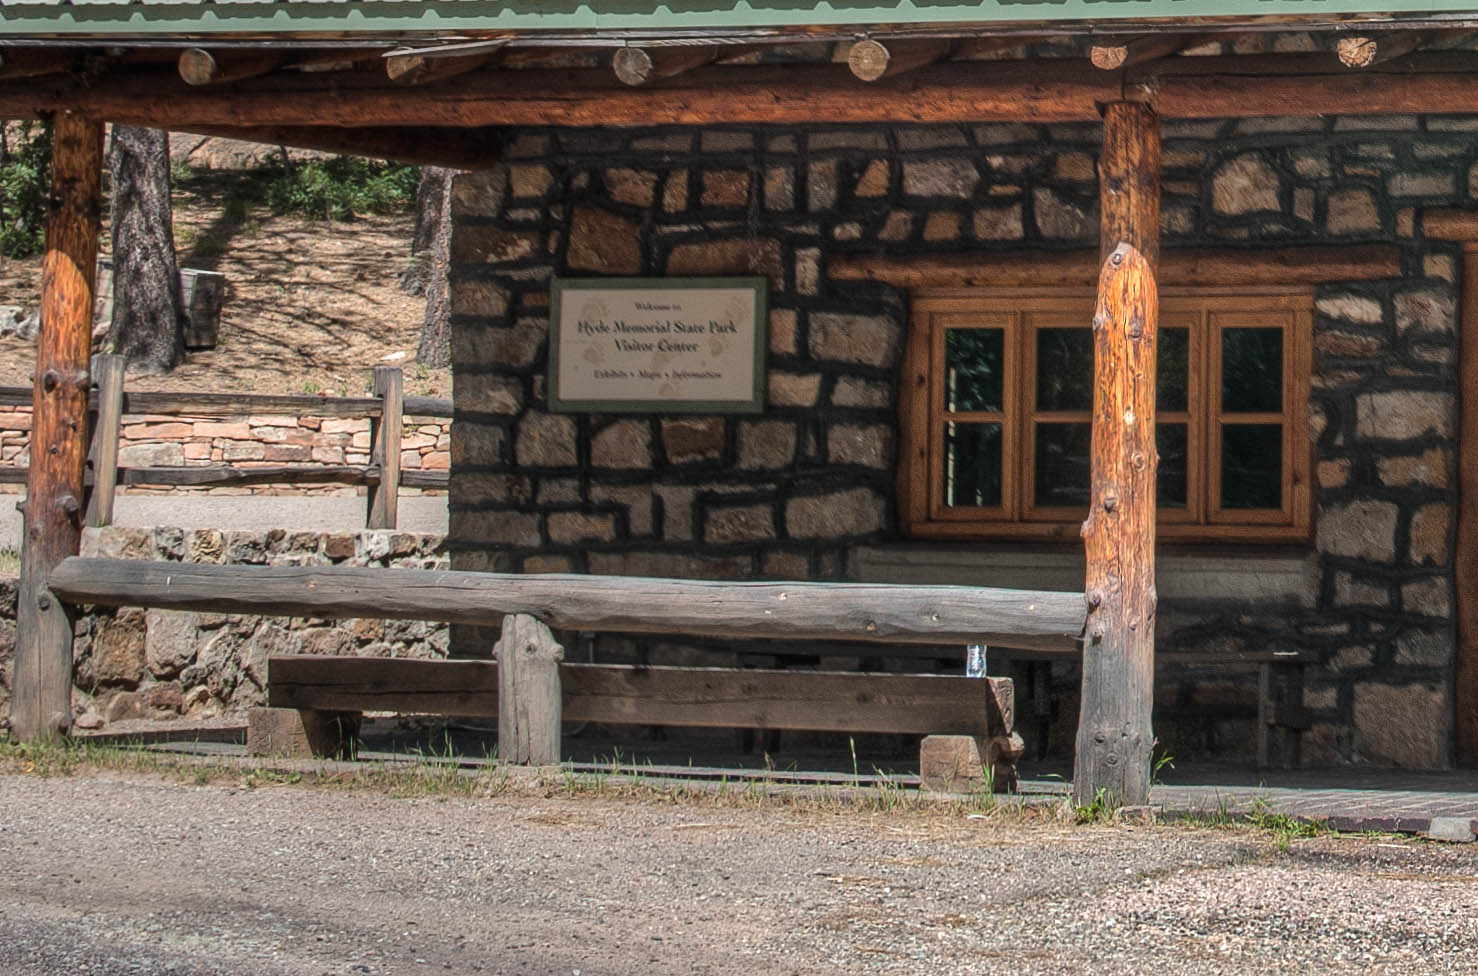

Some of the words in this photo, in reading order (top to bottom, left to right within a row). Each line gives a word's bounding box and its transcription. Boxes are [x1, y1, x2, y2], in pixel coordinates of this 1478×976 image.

[634, 302, 671, 311] Welcome
[577, 320, 609, 336] Hyde
[614, 320, 670, 334] Memorial
[673, 320, 705, 334] State
[709, 320, 738, 334] Park
[615, 339, 653, 352] Visitor
[657, 339, 698, 352] Center
